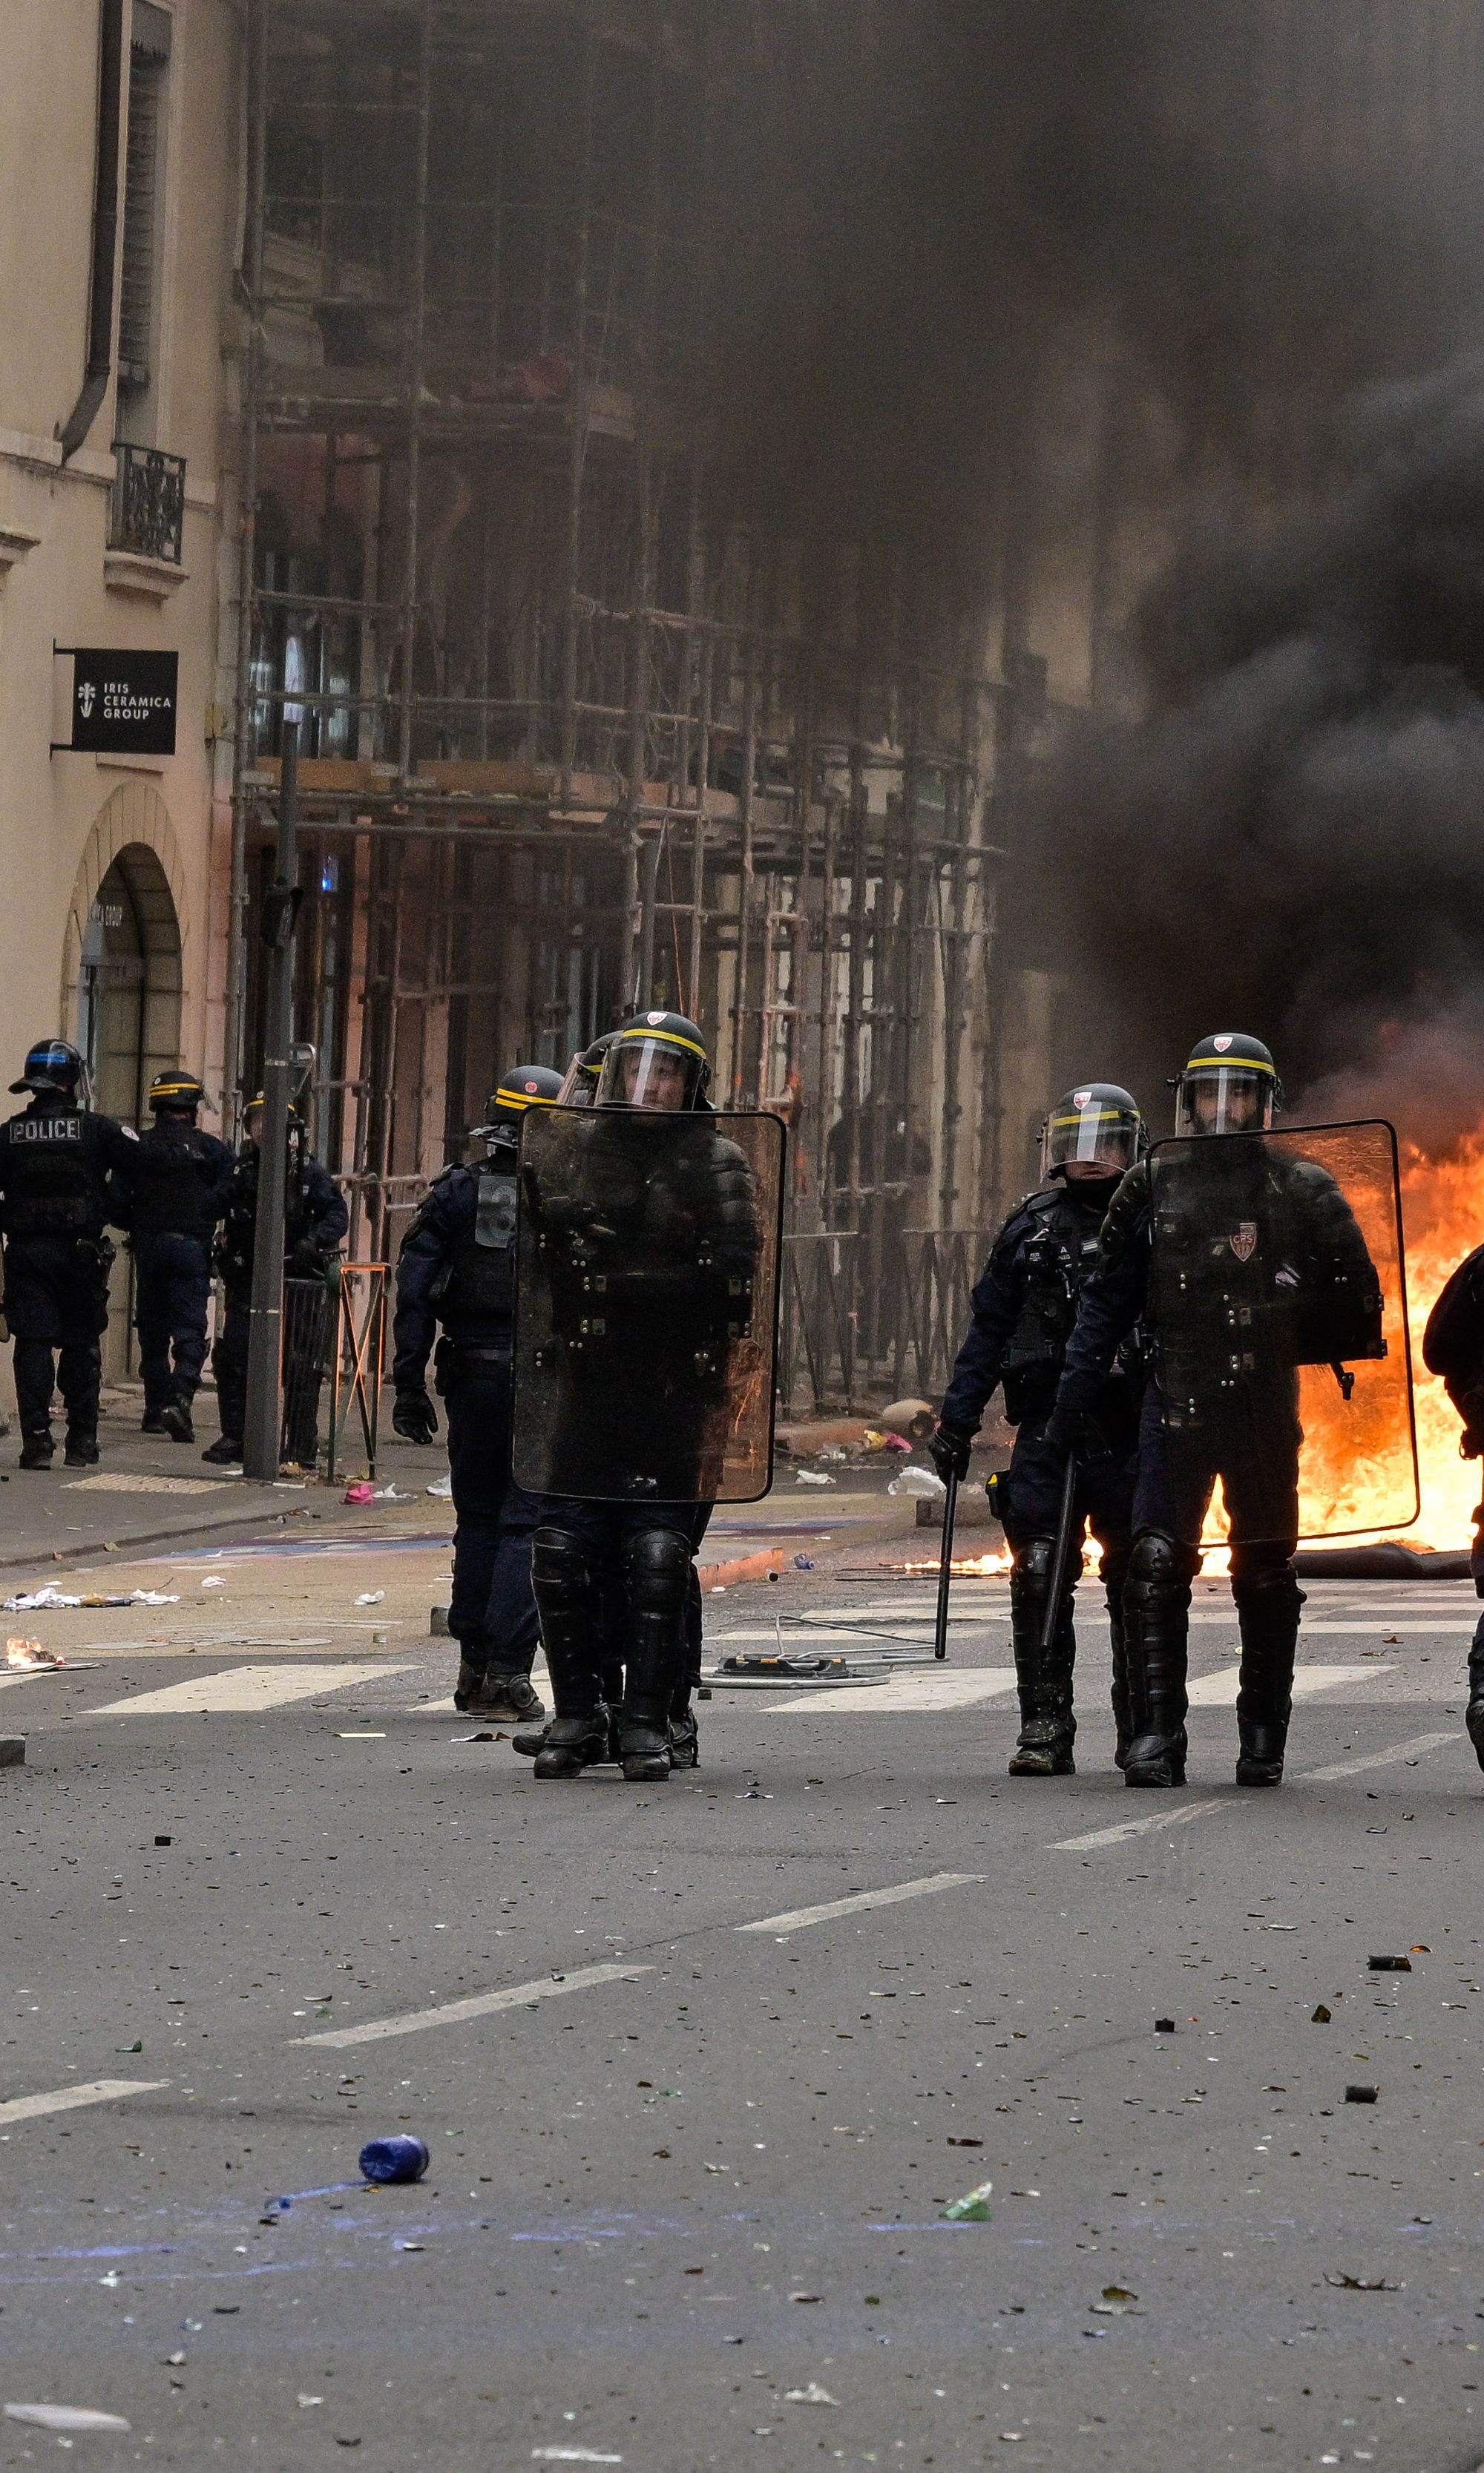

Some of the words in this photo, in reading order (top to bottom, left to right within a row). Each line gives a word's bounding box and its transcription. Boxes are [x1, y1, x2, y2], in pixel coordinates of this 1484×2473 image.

[104, 683, 128, 693] IRIS
[104, 695, 171, 708] CERAMICA
[104, 708, 149, 720] GROUP
[13, 1120, 76, 1140] POLICE
